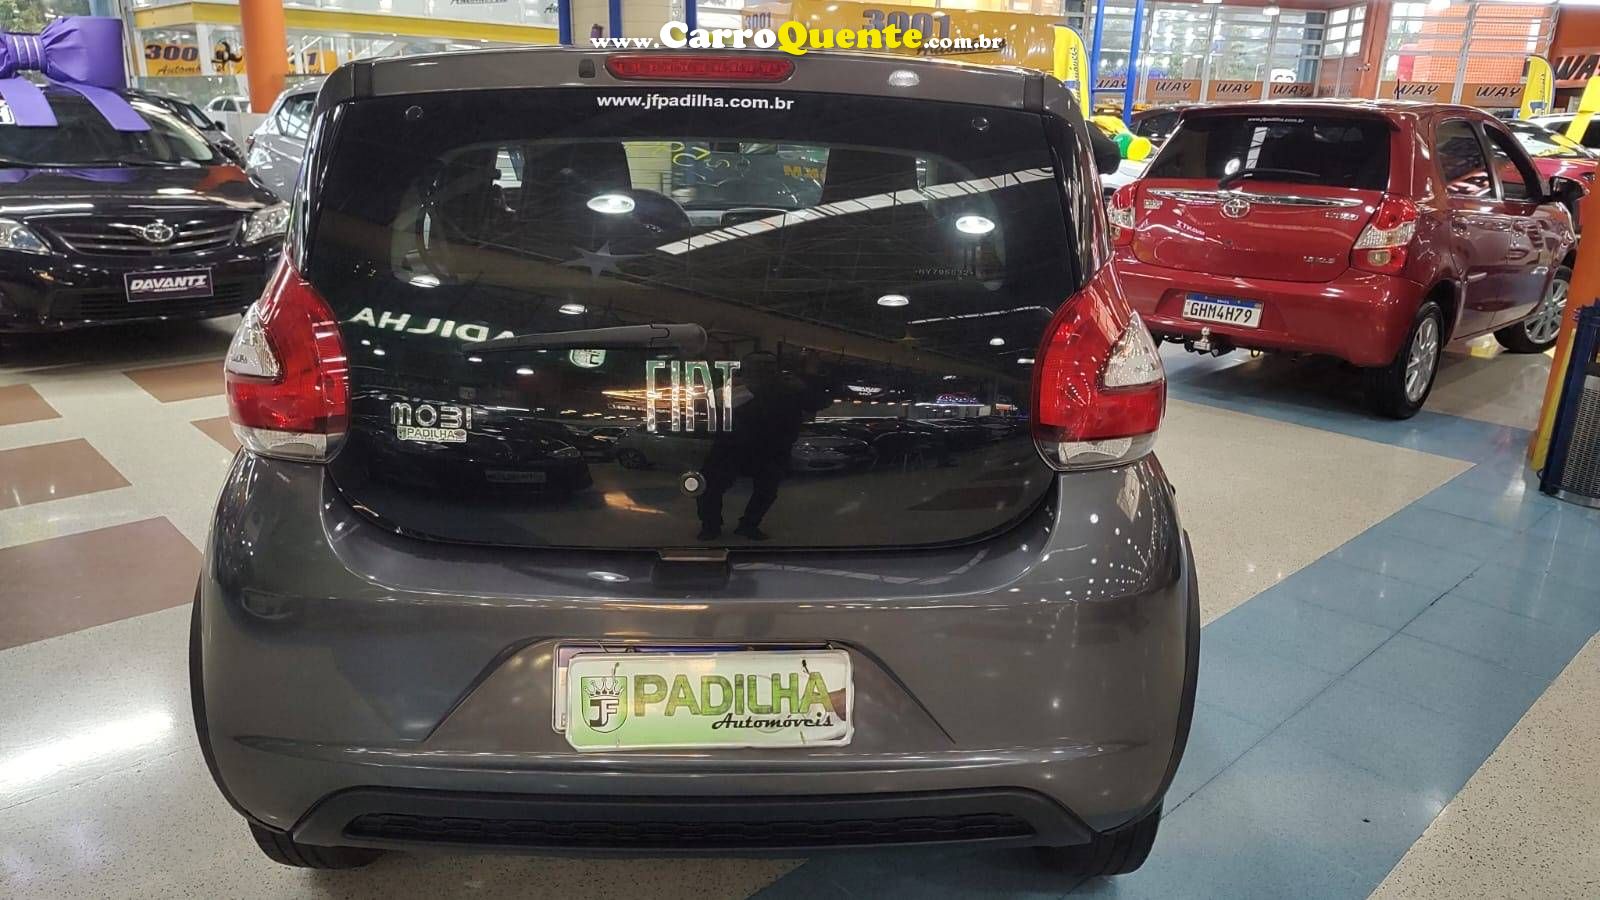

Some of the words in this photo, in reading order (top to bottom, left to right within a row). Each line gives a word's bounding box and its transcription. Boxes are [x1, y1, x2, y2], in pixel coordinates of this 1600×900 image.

[1554, 54, 1600, 81] WA
[1155, 82, 1191, 91] WAY
[1216, 83, 1252, 93] WAY
[1273, 85, 1308, 95] WAY
[1394, 83, 1439, 95] WAY
[1476, 86, 1521, 98] WAY
[597, 93, 795, 110] www.jfpadilha.com.br
[130, 275, 207, 291] DAVANTI
[1190, 302, 1253, 324] GHM4H79
[645, 360, 741, 432] FIAT
[390, 401, 472, 430] MOBI
[407, 427, 455, 439] PADILHA
[633, 671, 835, 717] PADILHA
[711, 711, 835, 730] Automóveis
